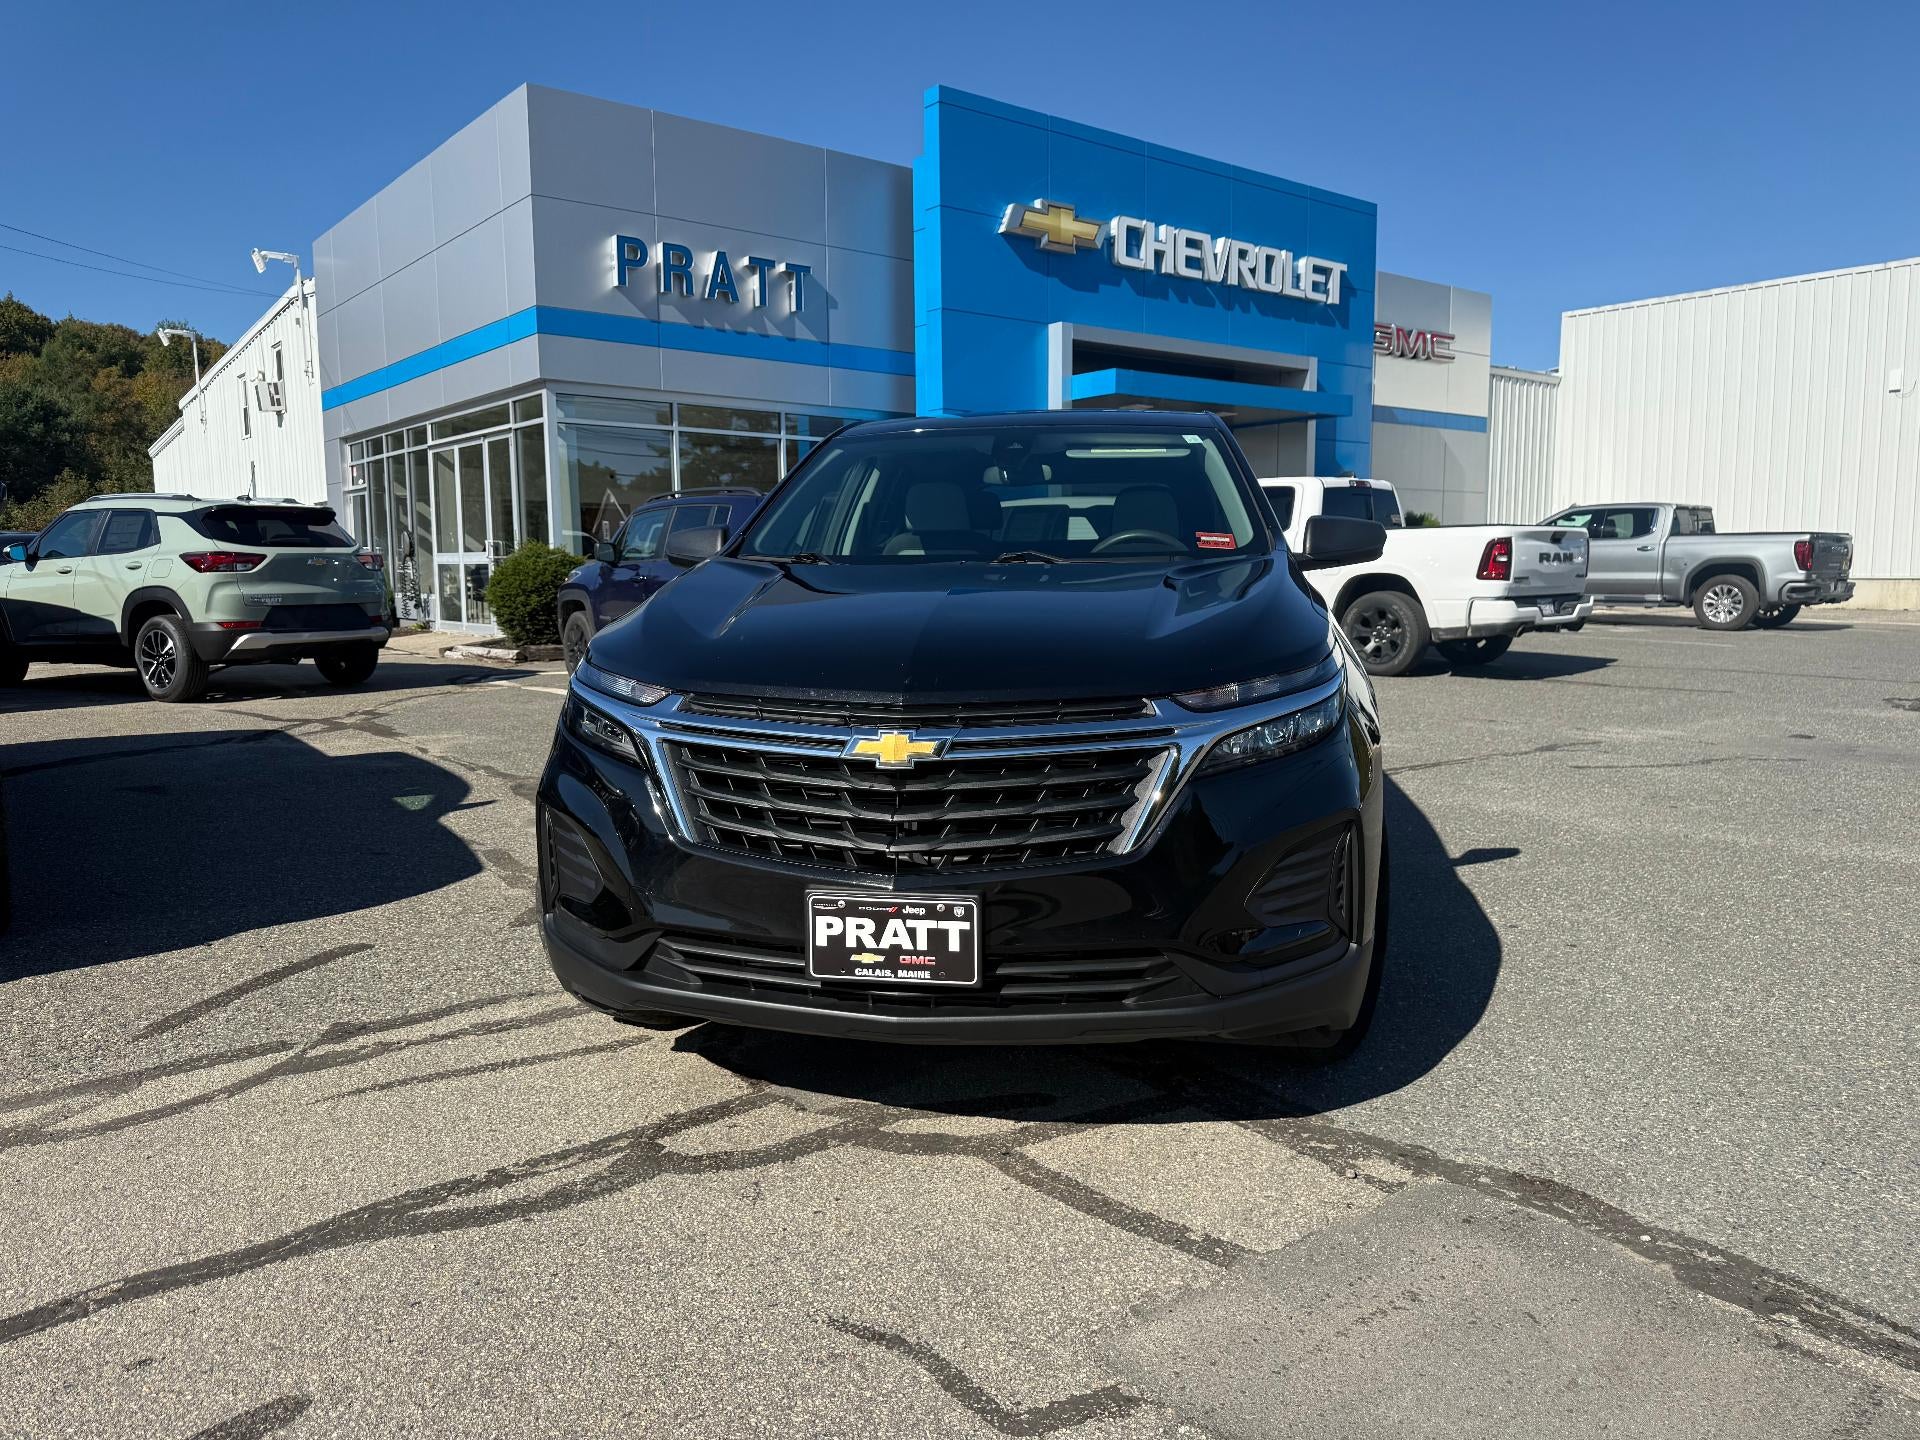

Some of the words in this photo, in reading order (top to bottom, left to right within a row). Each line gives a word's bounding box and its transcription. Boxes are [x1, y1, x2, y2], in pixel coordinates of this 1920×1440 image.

[1111, 215, 1348, 305] CHEVROLET
[611, 233, 812, 312] PRATT
[902, 905, 926, 915] Jeep
[815, 915, 971, 952] PRATT
[899, 955, 936, 965] GMC
[855, 967, 894, 978] CALAIS,
[898, 969, 931, 979] MAINE
